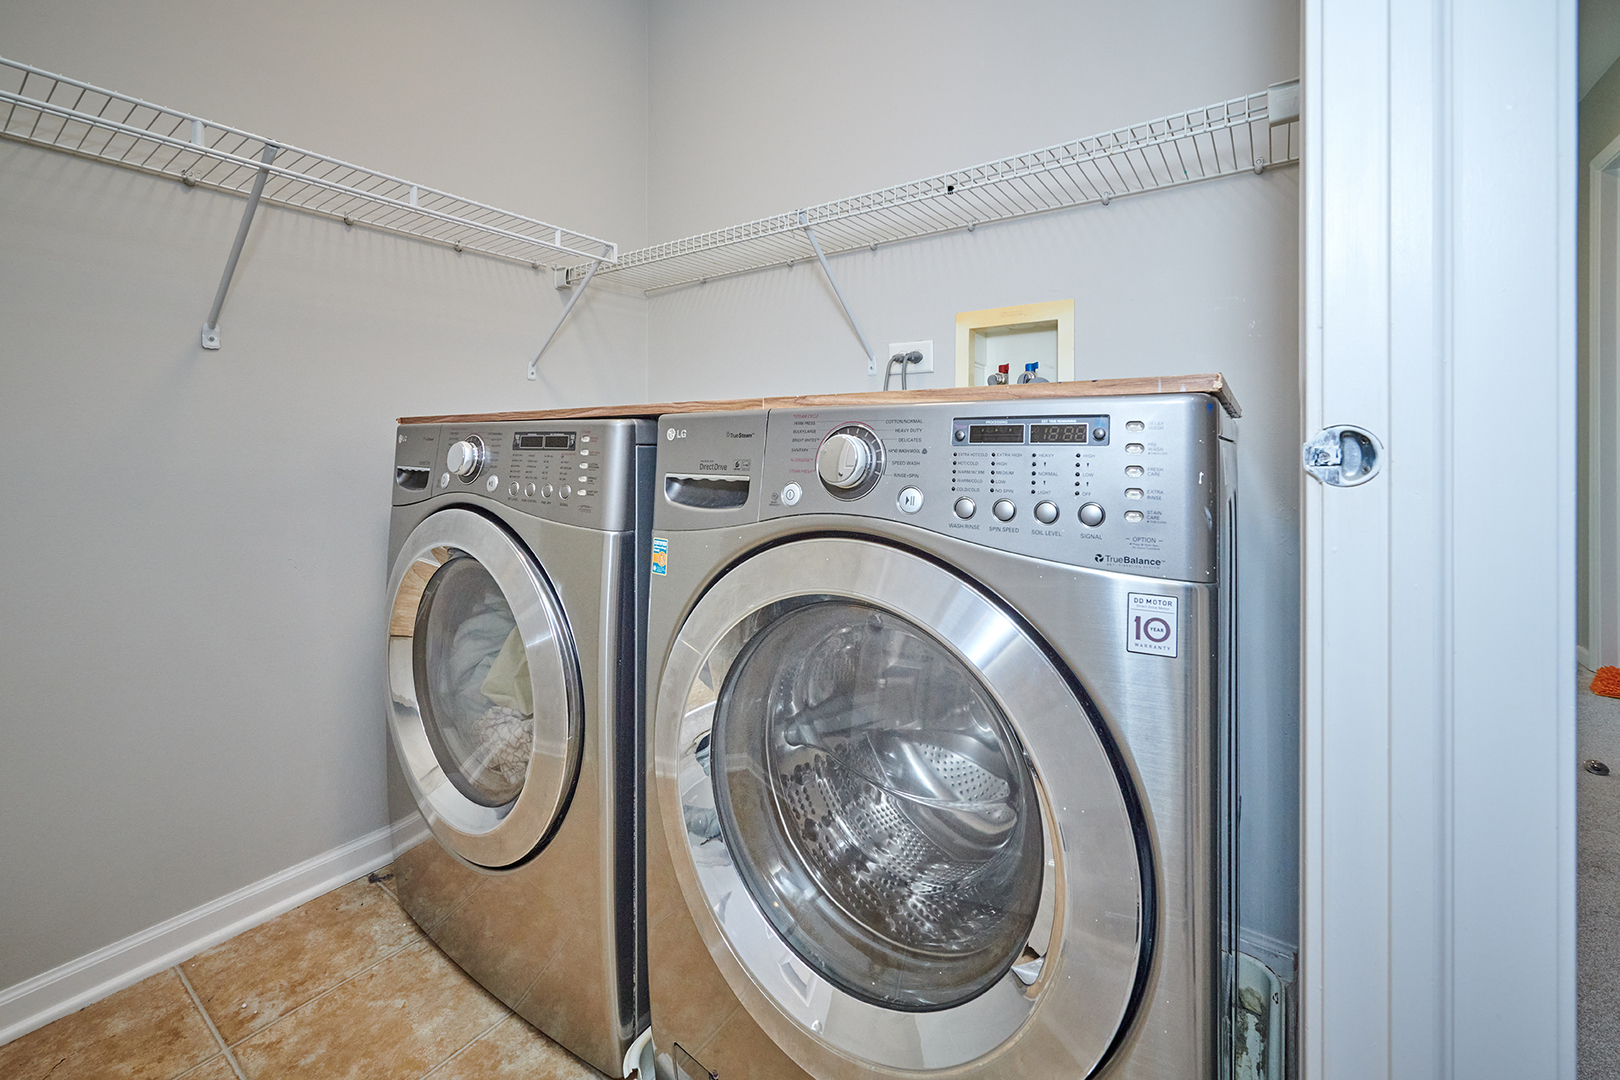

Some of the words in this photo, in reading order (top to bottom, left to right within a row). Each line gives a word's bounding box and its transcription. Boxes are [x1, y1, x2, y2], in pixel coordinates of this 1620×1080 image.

[676, 429, 687, 438] LG
[1132, 536, 1157, 544] OPTION
[1146, 599, 1173, 607] MOTOR
[1134, 615, 1171, 643] 10
